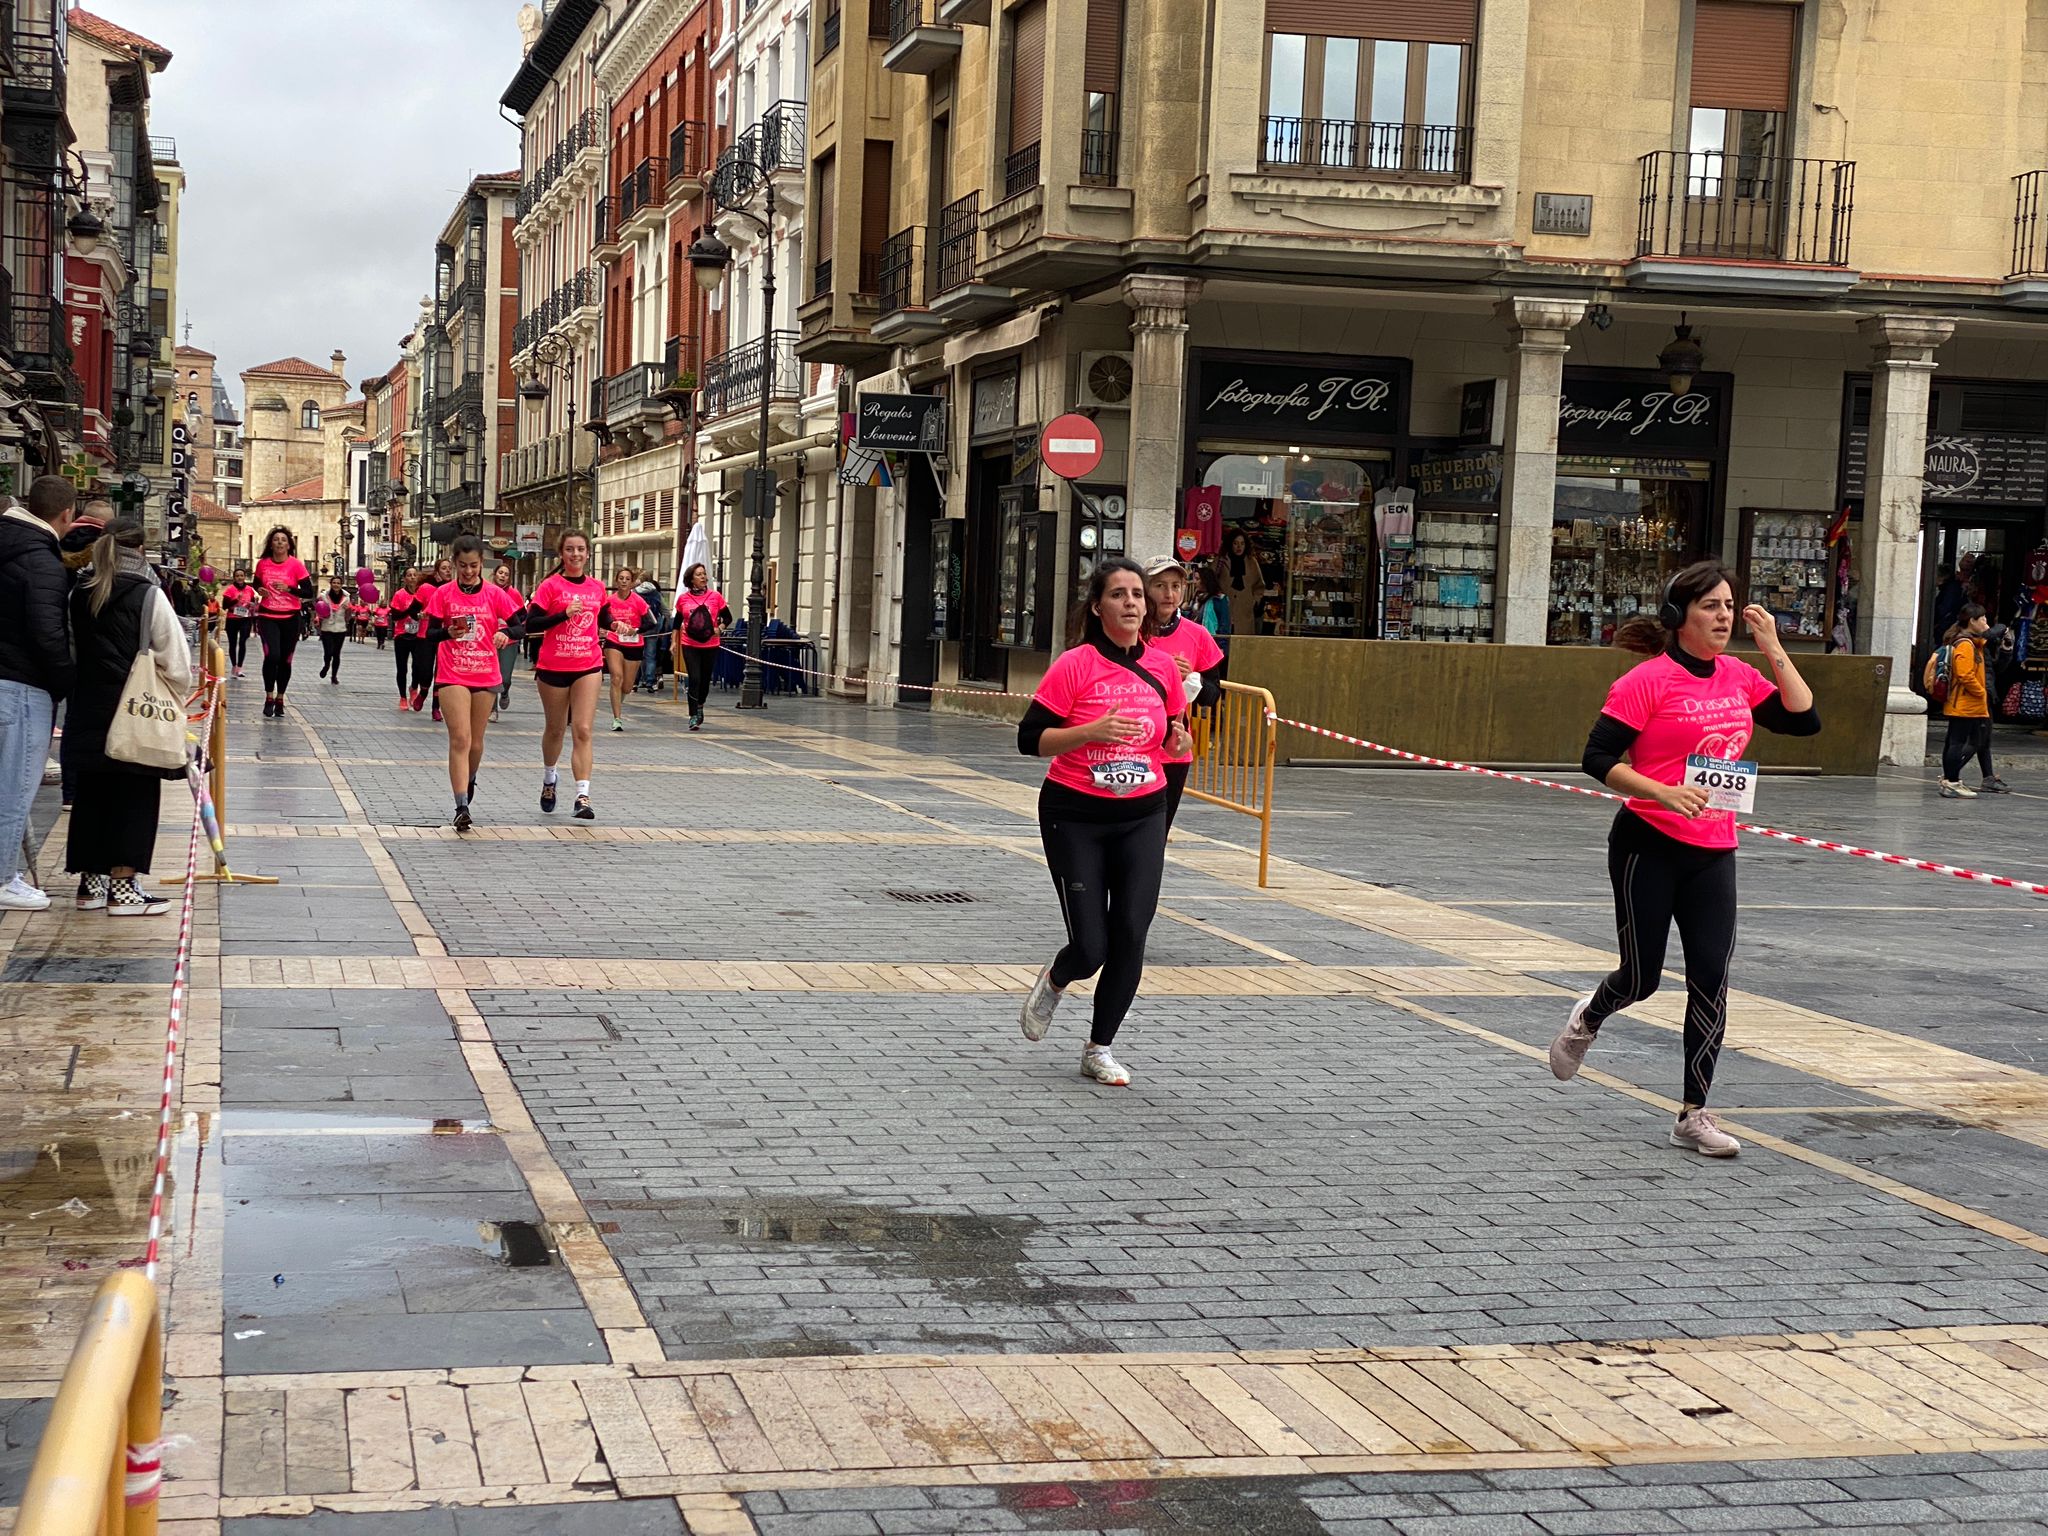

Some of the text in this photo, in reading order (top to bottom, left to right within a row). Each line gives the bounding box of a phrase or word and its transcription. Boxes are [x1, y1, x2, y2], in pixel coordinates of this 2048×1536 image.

[863, 401, 913, 422] Regalos
[863, 425, 917, 442] Souvenir
[1928, 454, 1967, 474] NAURA
[1422, 474, 1496, 495] DE LEON
[1106, 752, 1152, 765] CARRERA
[1708, 762, 1750, 774] solitium
[1103, 772, 1146, 784] 4077
[1694, 770, 1747, 792] 4038
